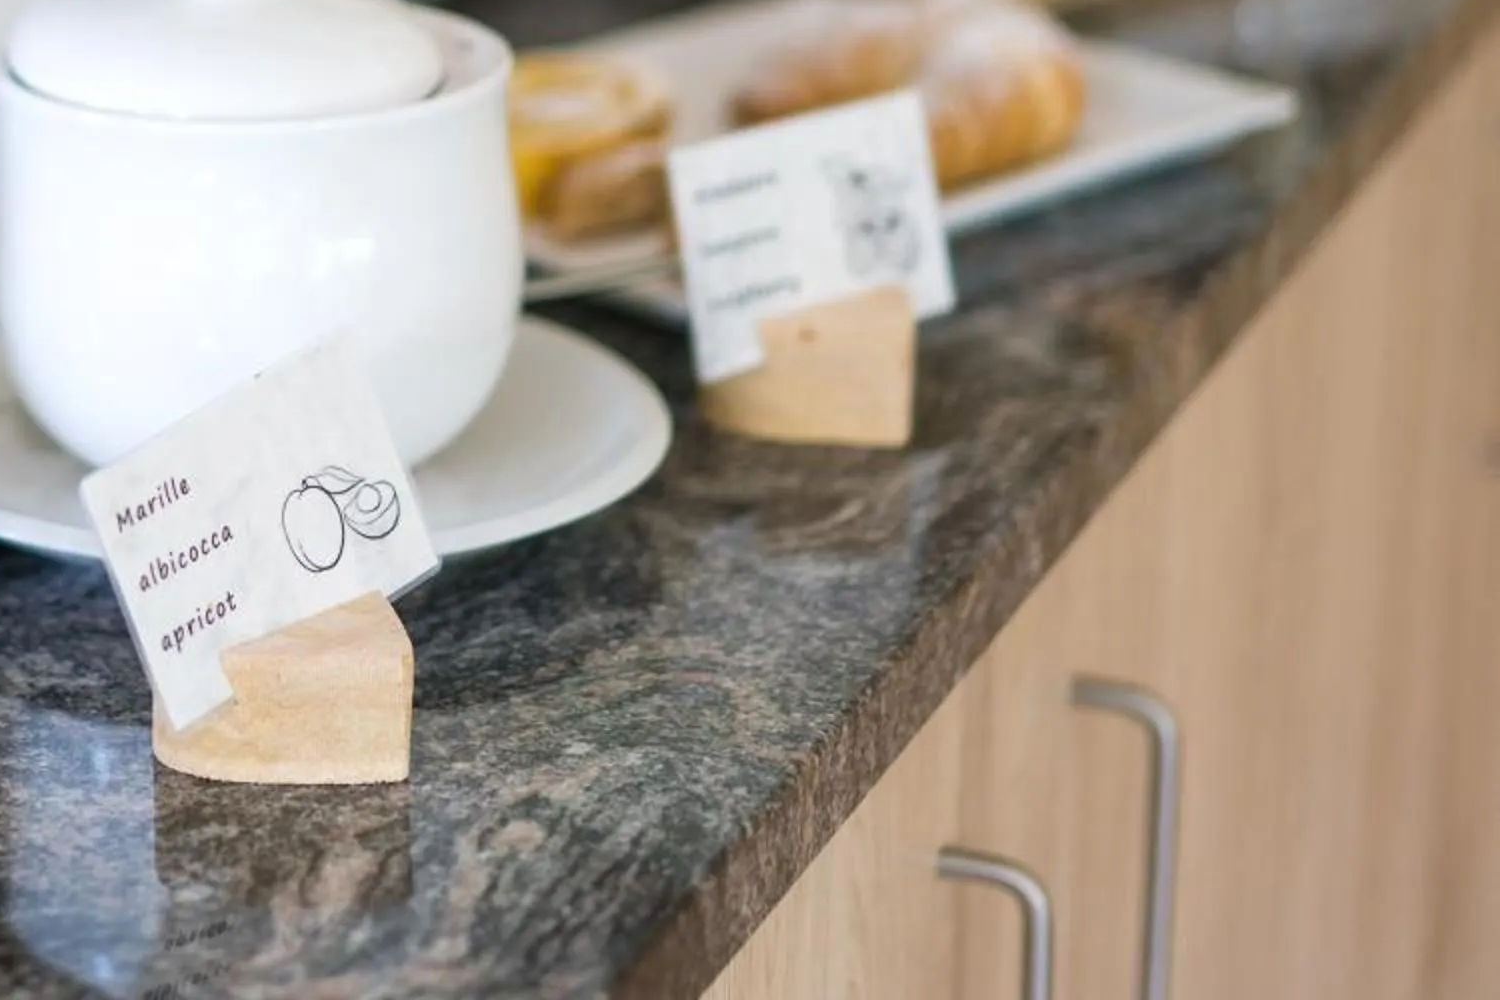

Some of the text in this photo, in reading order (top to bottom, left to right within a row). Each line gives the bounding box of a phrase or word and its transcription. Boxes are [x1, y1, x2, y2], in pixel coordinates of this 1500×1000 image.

[116, 477, 191, 533] Marille
[138, 524, 234, 592] albicocca
[161, 592, 237, 653] apricot
